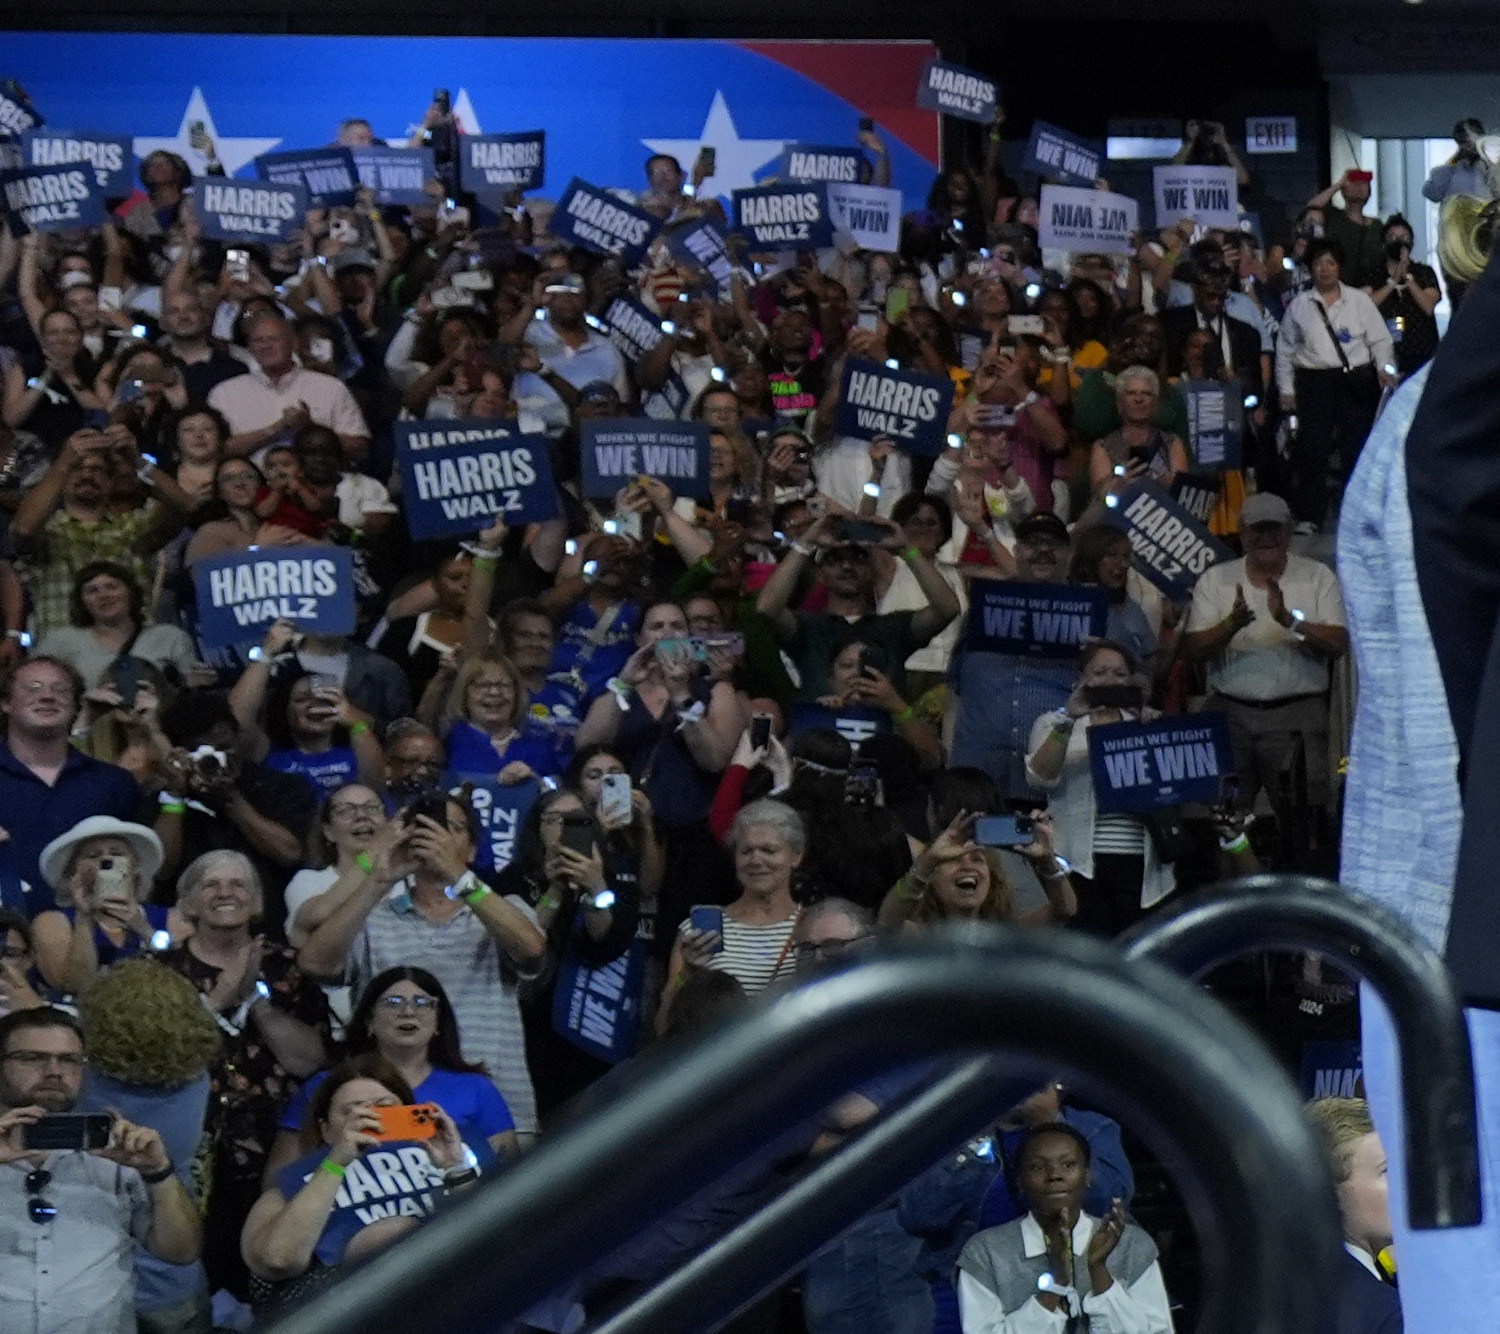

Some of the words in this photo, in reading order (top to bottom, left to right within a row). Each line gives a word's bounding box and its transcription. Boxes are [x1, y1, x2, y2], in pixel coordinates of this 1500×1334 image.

[928, 66, 998, 104] HARRIS
[938, 88, 986, 114] WALZ
[1254, 122, 1289, 148] EXIT
[31, 137, 123, 173] HARRIS
[471, 140, 542, 169] HARRIS
[788, 151, 858, 183] HARRIS
[204, 184, 297, 222] HARRIS
[740, 191, 820, 227] HARRIS
[1162, 188, 1189, 212] WE
[1192, 187, 1230, 212] WIN
[219, 214, 282, 237] WALZ
[567, 188, 653, 247] HARRIS
[754, 221, 811, 244] WALZ
[849, 205, 891, 234] WIN
[572, 217, 627, 255] WALZ
[848, 370, 941, 417] HARRIS
[595, 433, 632, 445] WHEN
[655, 434, 696, 447] FIGHT
[857, 409, 918, 440] WALZ
[413, 448, 537, 501] HARRIS
[595, 445, 638, 477] WE
[643, 446, 697, 478] WIN
[441, 489, 525, 521] WALZ
[1126, 492, 1215, 576] HARRIS
[1126, 528, 1184, 582] WALZ
[209, 559, 337, 608] HARRIS
[234, 598, 319, 627] WALZ
[985, 593, 1023, 607] WHEN
[1052, 598, 1092, 614] FIGHT
[984, 607, 1025, 638] WE
[1032, 610, 1091, 645] WIN
[1104, 736, 1143, 754] WHEN
[1172, 727, 1214, 744] FIGHT
[1104, 747, 1151, 789] WE
[1154, 741, 1219, 784] WIN
